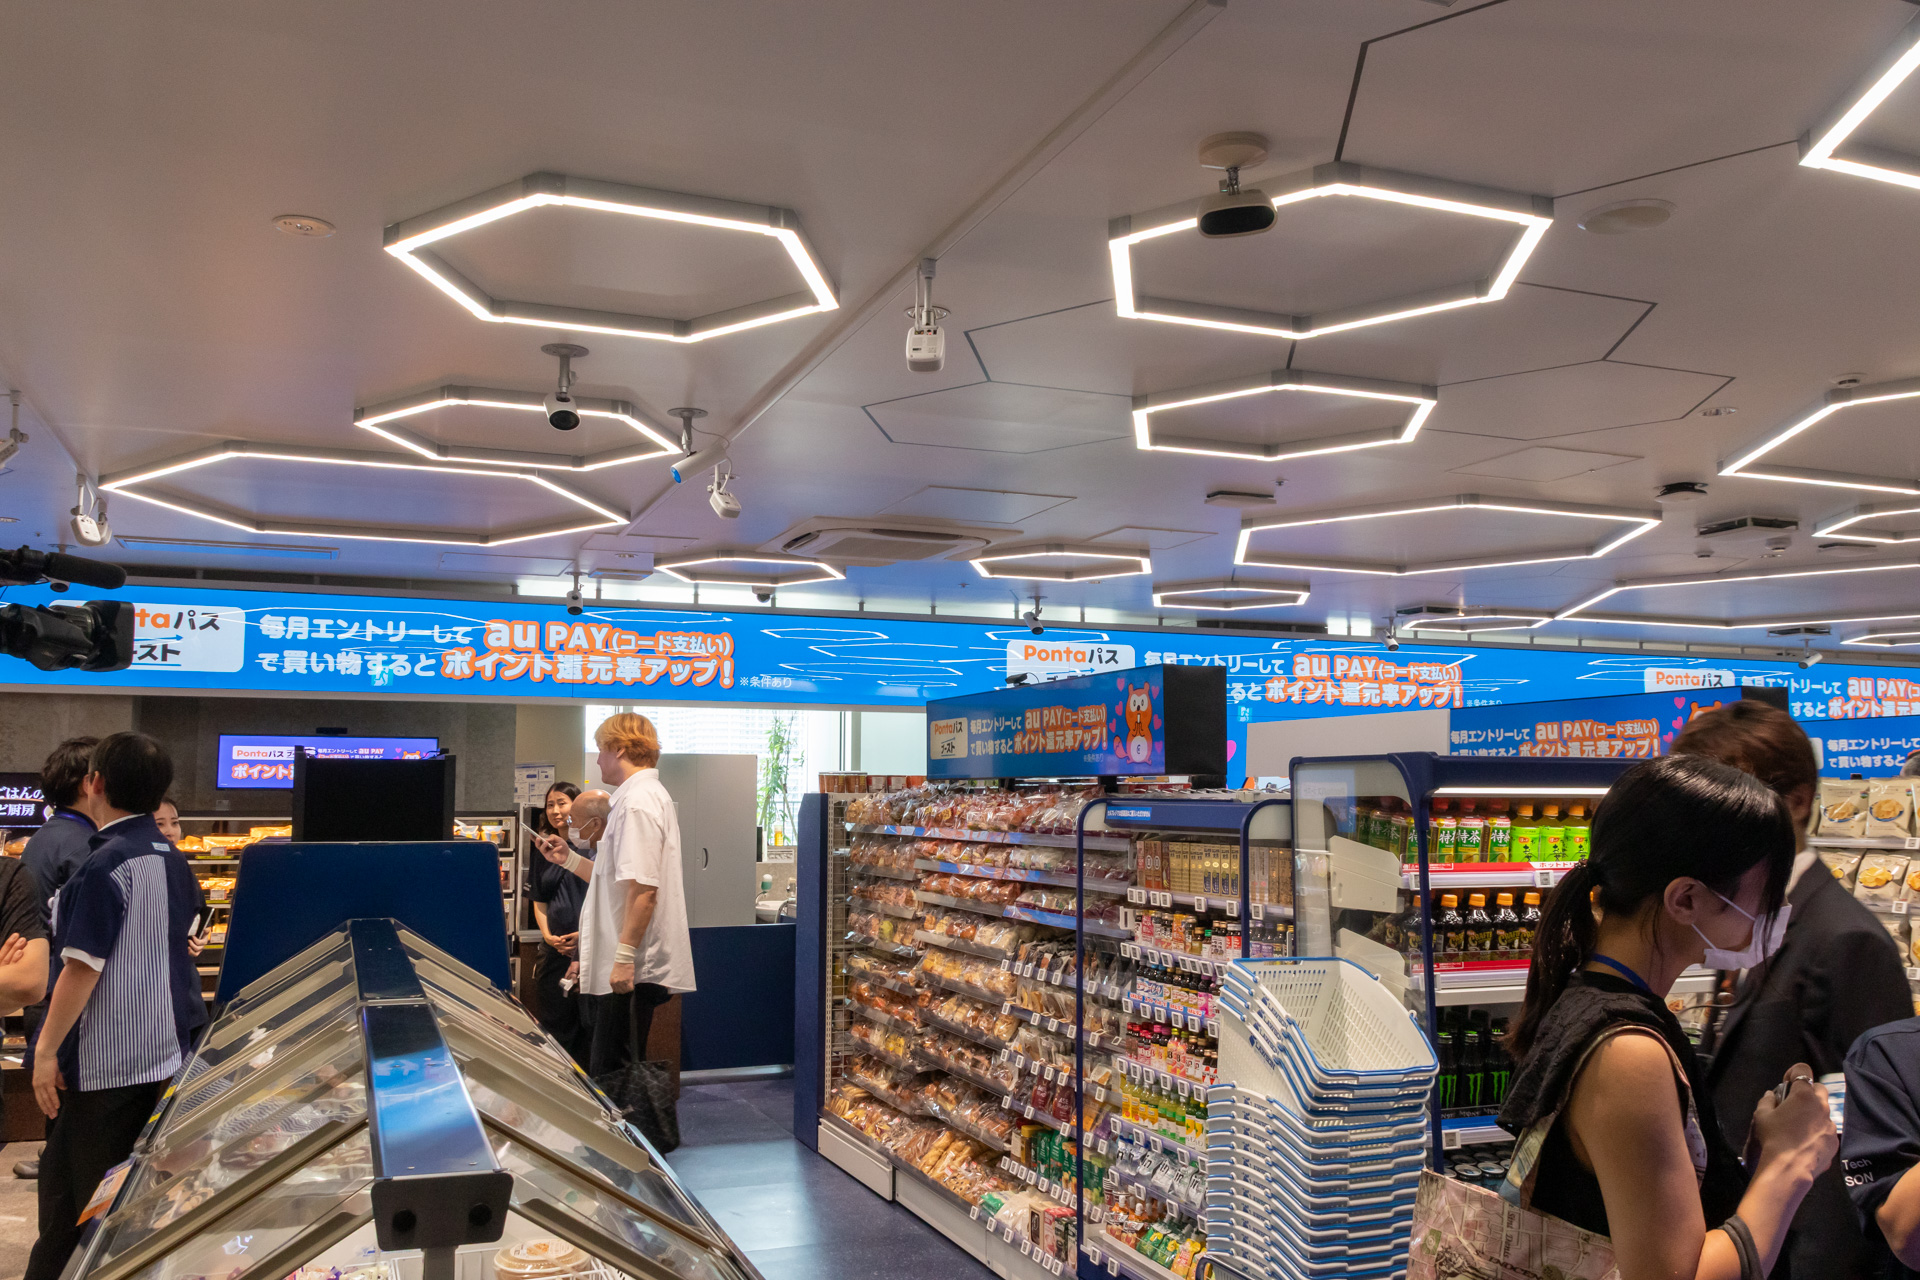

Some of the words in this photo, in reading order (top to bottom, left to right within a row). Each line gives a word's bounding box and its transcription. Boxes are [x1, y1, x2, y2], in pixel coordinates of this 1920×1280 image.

[135, 608, 220, 631] taパス
[259, 614, 473, 644] 毎月エントリーして
[487, 624, 537, 649] au
[133, 643, 181, 661] スト
[1024, 644, 1119, 665] Pontaパス
[1295, 656, 1328, 677] au
[1656, 671, 1723, 687] Pontaパス
[1848, 679, 1873, 697] au
[970, 717, 1022, 734] 毎月エントリーして
[1025, 711, 1040, 730] au
[1450, 728, 1530, 744] 毎月エントリーして
[1536, 724, 1558, 740] au
[233, 764, 295, 779] ポイント
[1456, 829, 1481, 844] 特茶
[1841, 1158, 1873, 1171] Tech
